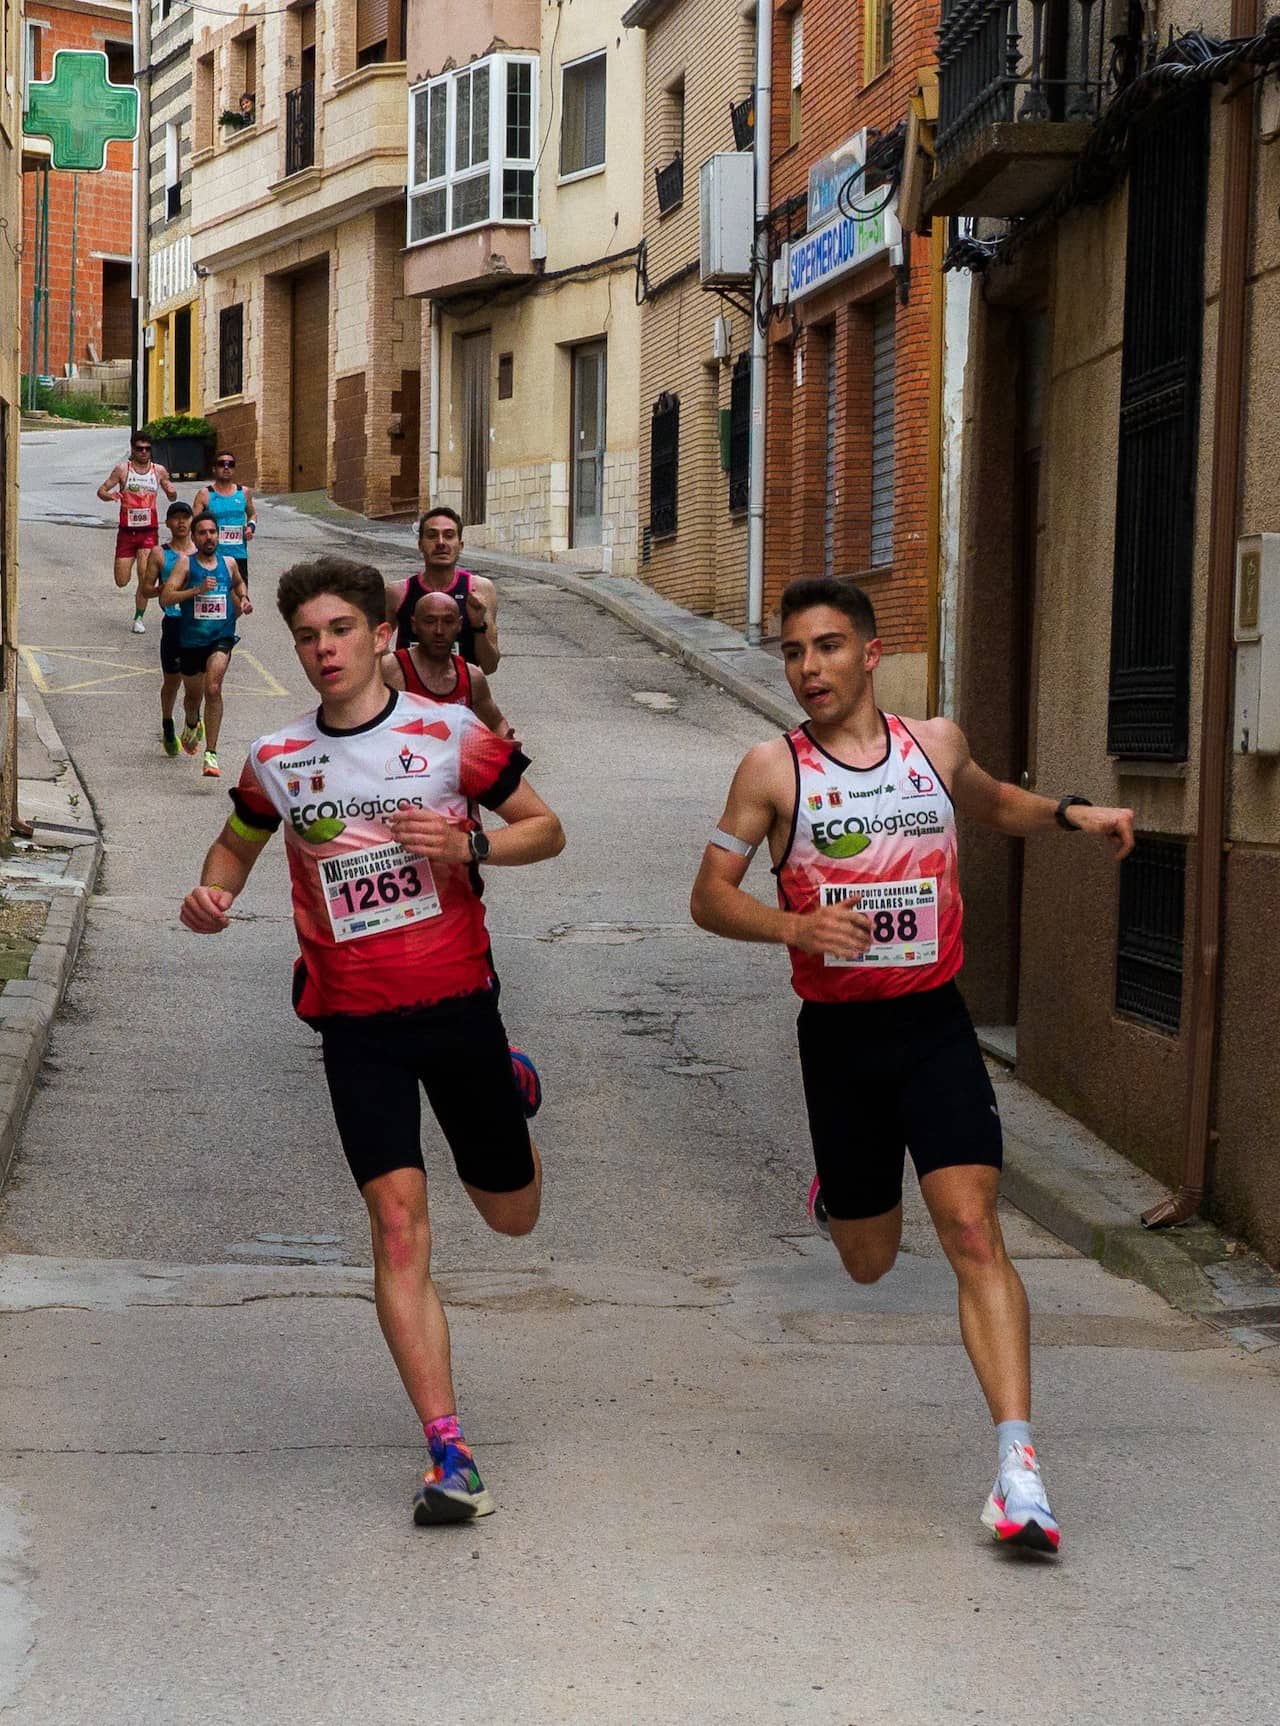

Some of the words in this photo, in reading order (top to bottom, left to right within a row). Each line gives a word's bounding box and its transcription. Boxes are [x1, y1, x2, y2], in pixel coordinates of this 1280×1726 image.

[791, 216, 855, 293] SUPERMERCADO
[201, 602, 220, 613] 824
[279, 756, 316, 770] luanvi
[848, 785, 882, 799] luanvi
[289, 794, 423, 833] ECOlógicos
[811, 809, 938, 844] ECOlógicos
[903, 825, 945, 837] rujamar
[341, 854, 369, 869] CIRCUITO
[343, 859, 392, 880] POPULARES
[322, 859, 343, 884] XXI
[338, 865, 422, 913] 1263
[883, 885, 918, 897] CARRERAS
[855, 897, 903, 910] OPULARES
[860, 909, 918, 943] 88
